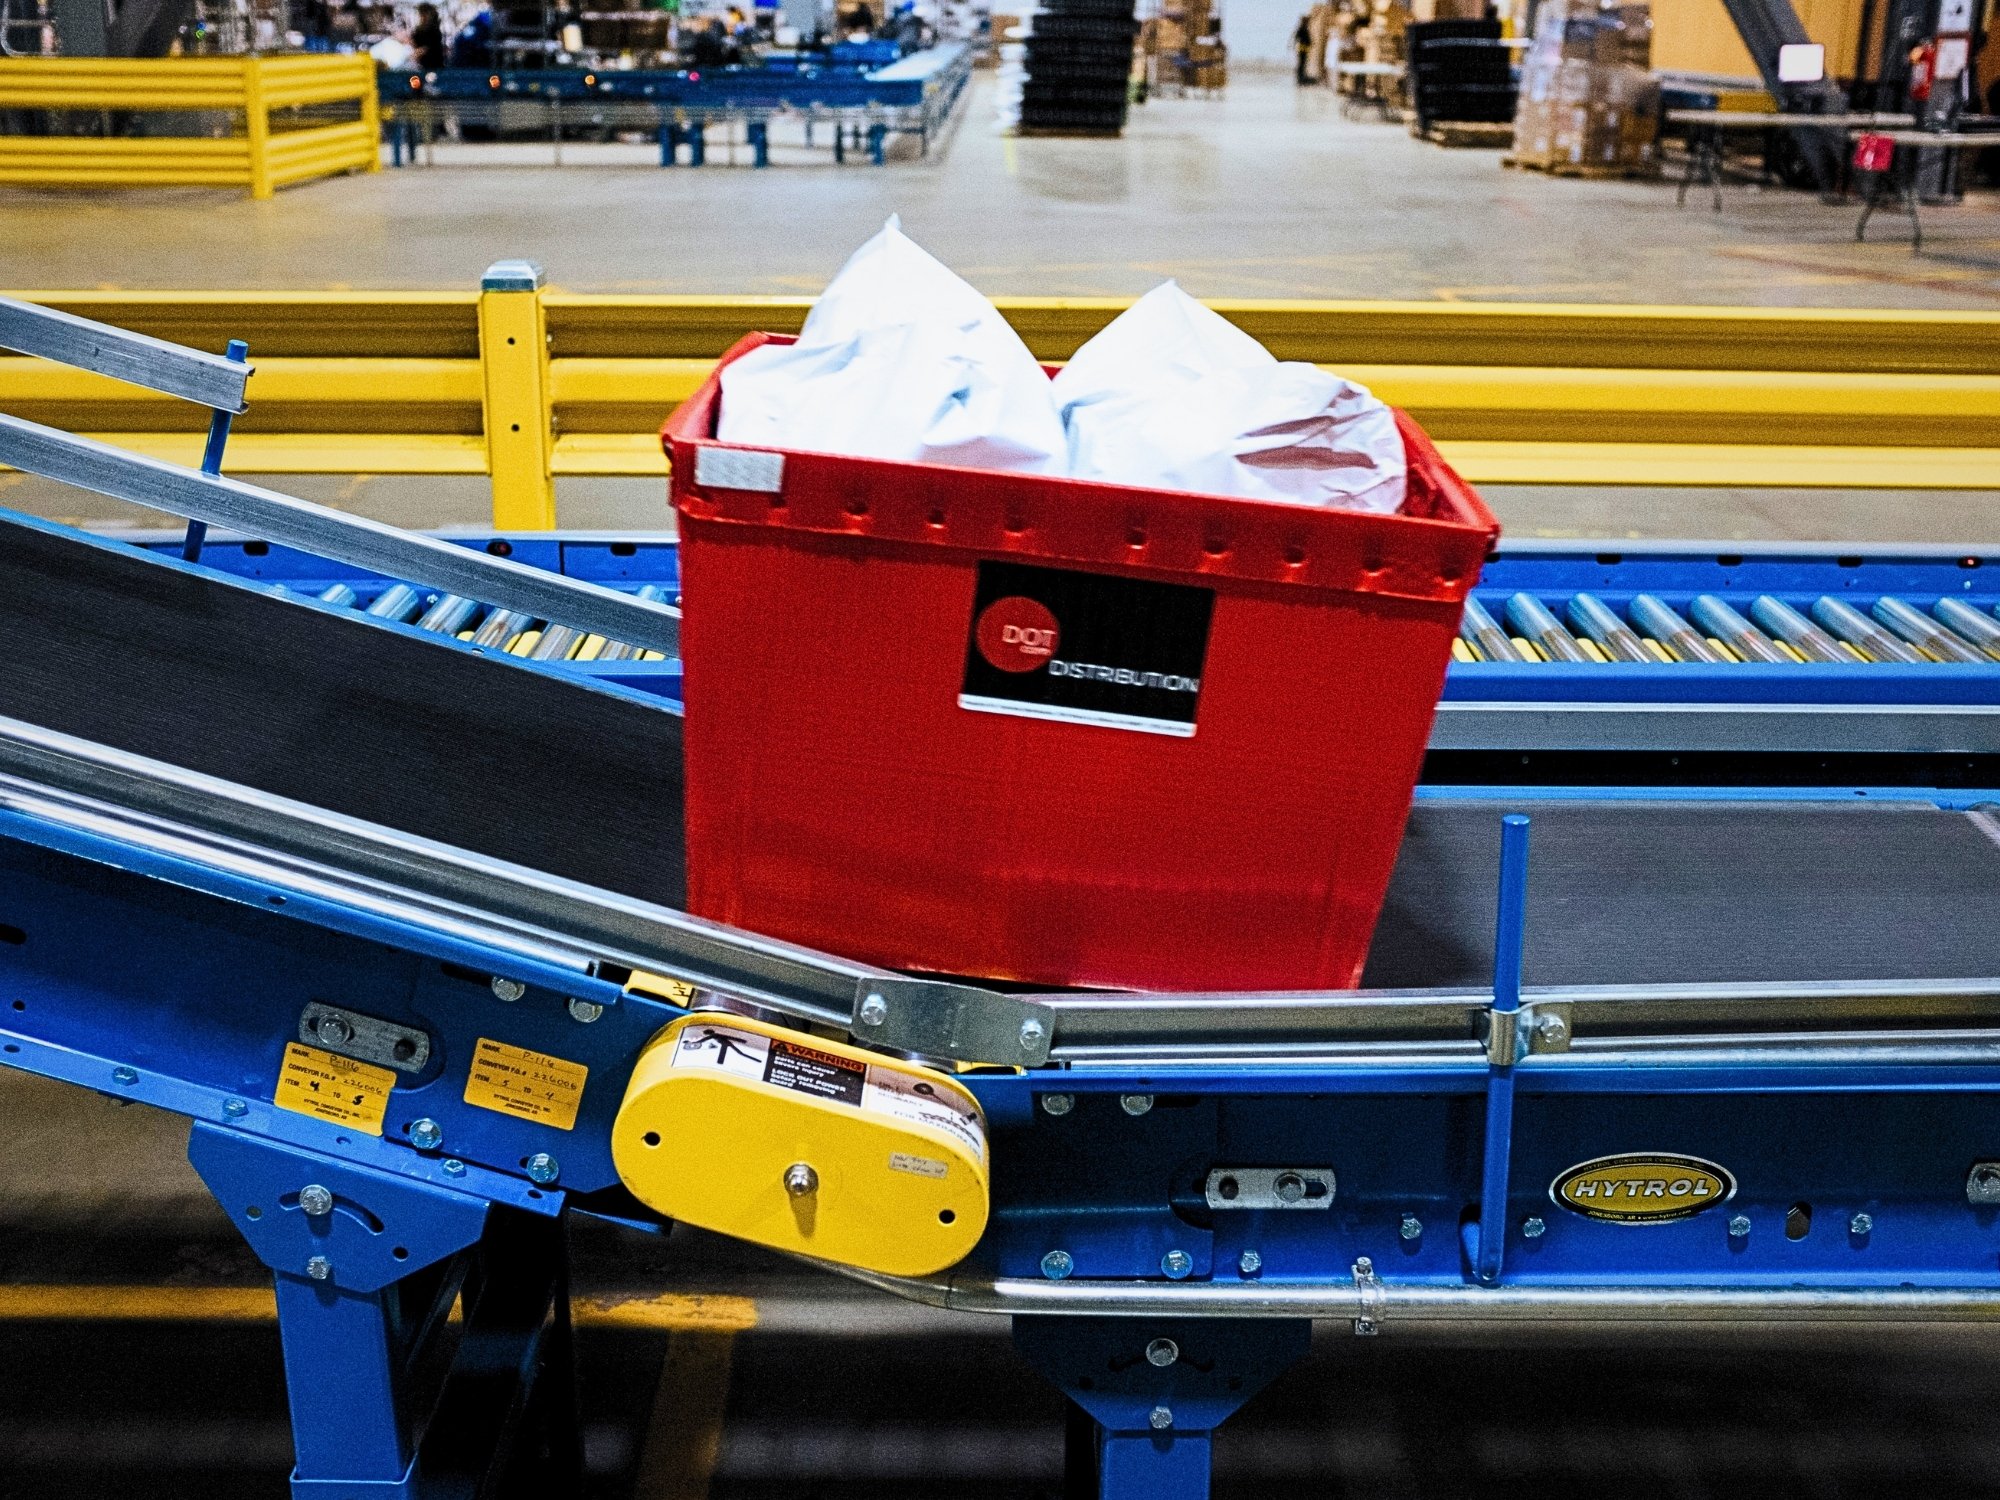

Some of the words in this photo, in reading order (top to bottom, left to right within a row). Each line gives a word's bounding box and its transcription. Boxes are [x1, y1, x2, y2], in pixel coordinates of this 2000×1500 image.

[1002, 624, 1056, 647] DOT
[1049, 660, 1199, 692] DISTRIBUTION
[292, 1048, 309, 1057] MARK
[482, 1043, 500, 1052] MARK
[479, 1058, 509, 1072] CONVEYOR
[791, 1045, 864, 1072] WARNING
[289, 1063, 319, 1077] CONVEYOR
[475, 1074, 490, 1082] ITEM
[772, 1068, 794, 1078] LOCK
[797, 1075, 814, 1083] OUT
[816, 1080, 846, 1092] POWER
[1574, 1178, 1710, 1197] HYTROL
